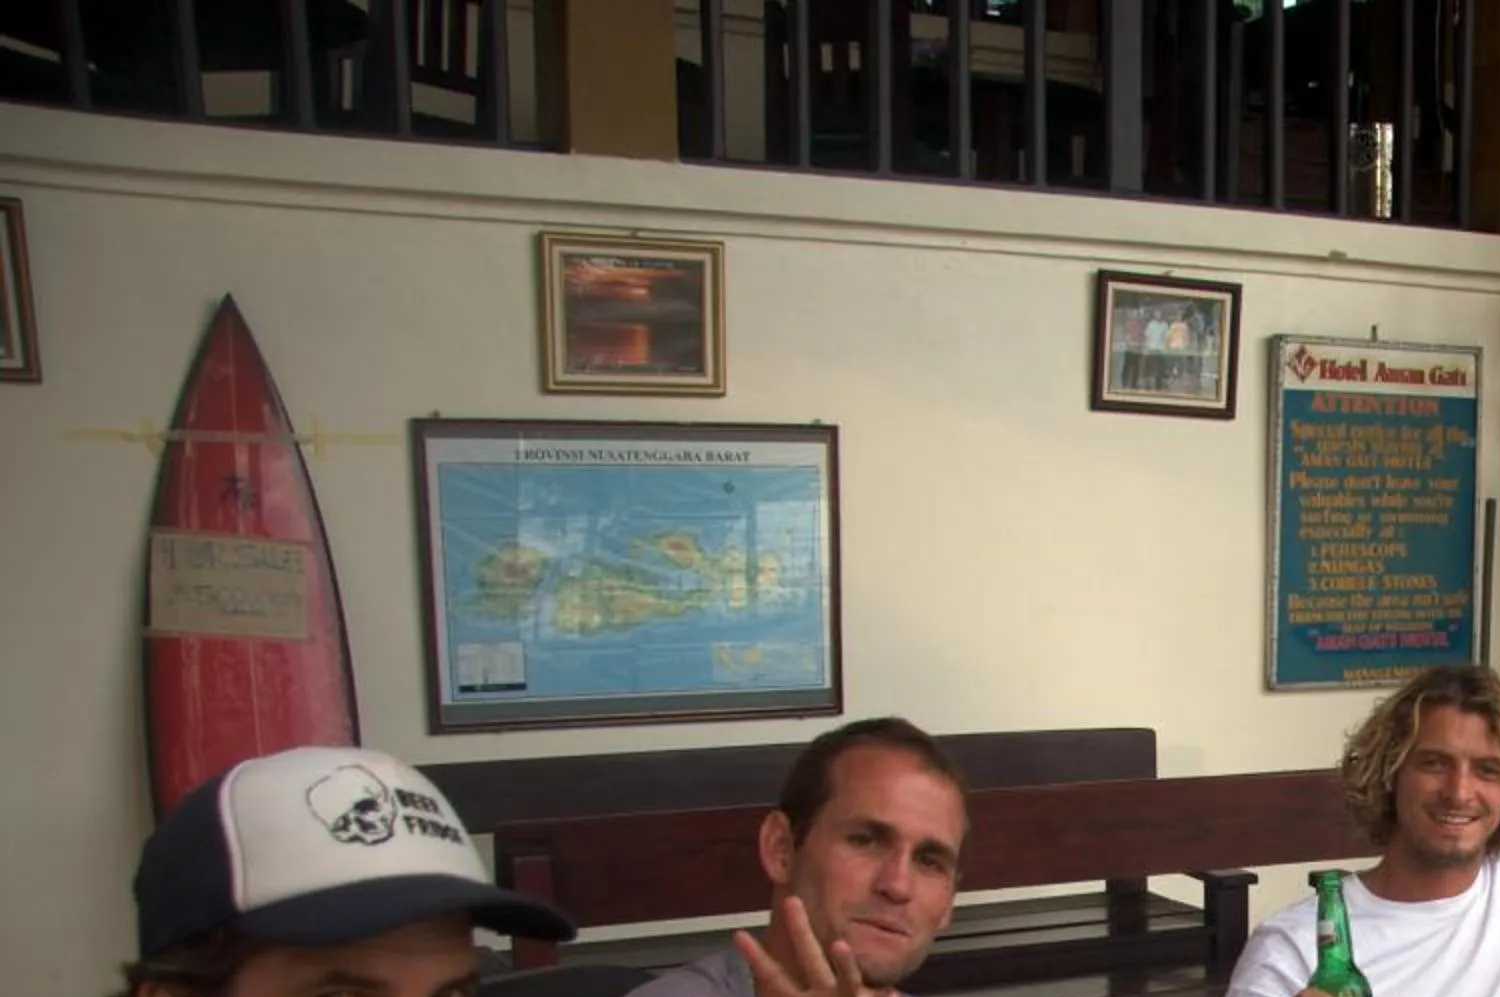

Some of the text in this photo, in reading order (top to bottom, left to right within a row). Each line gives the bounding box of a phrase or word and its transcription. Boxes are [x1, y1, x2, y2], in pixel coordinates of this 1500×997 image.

[1319, 359, 1367, 382] Hotel
[1311, 392, 1440, 416] ATTENTION
[705, 450, 751, 463] BARAT
